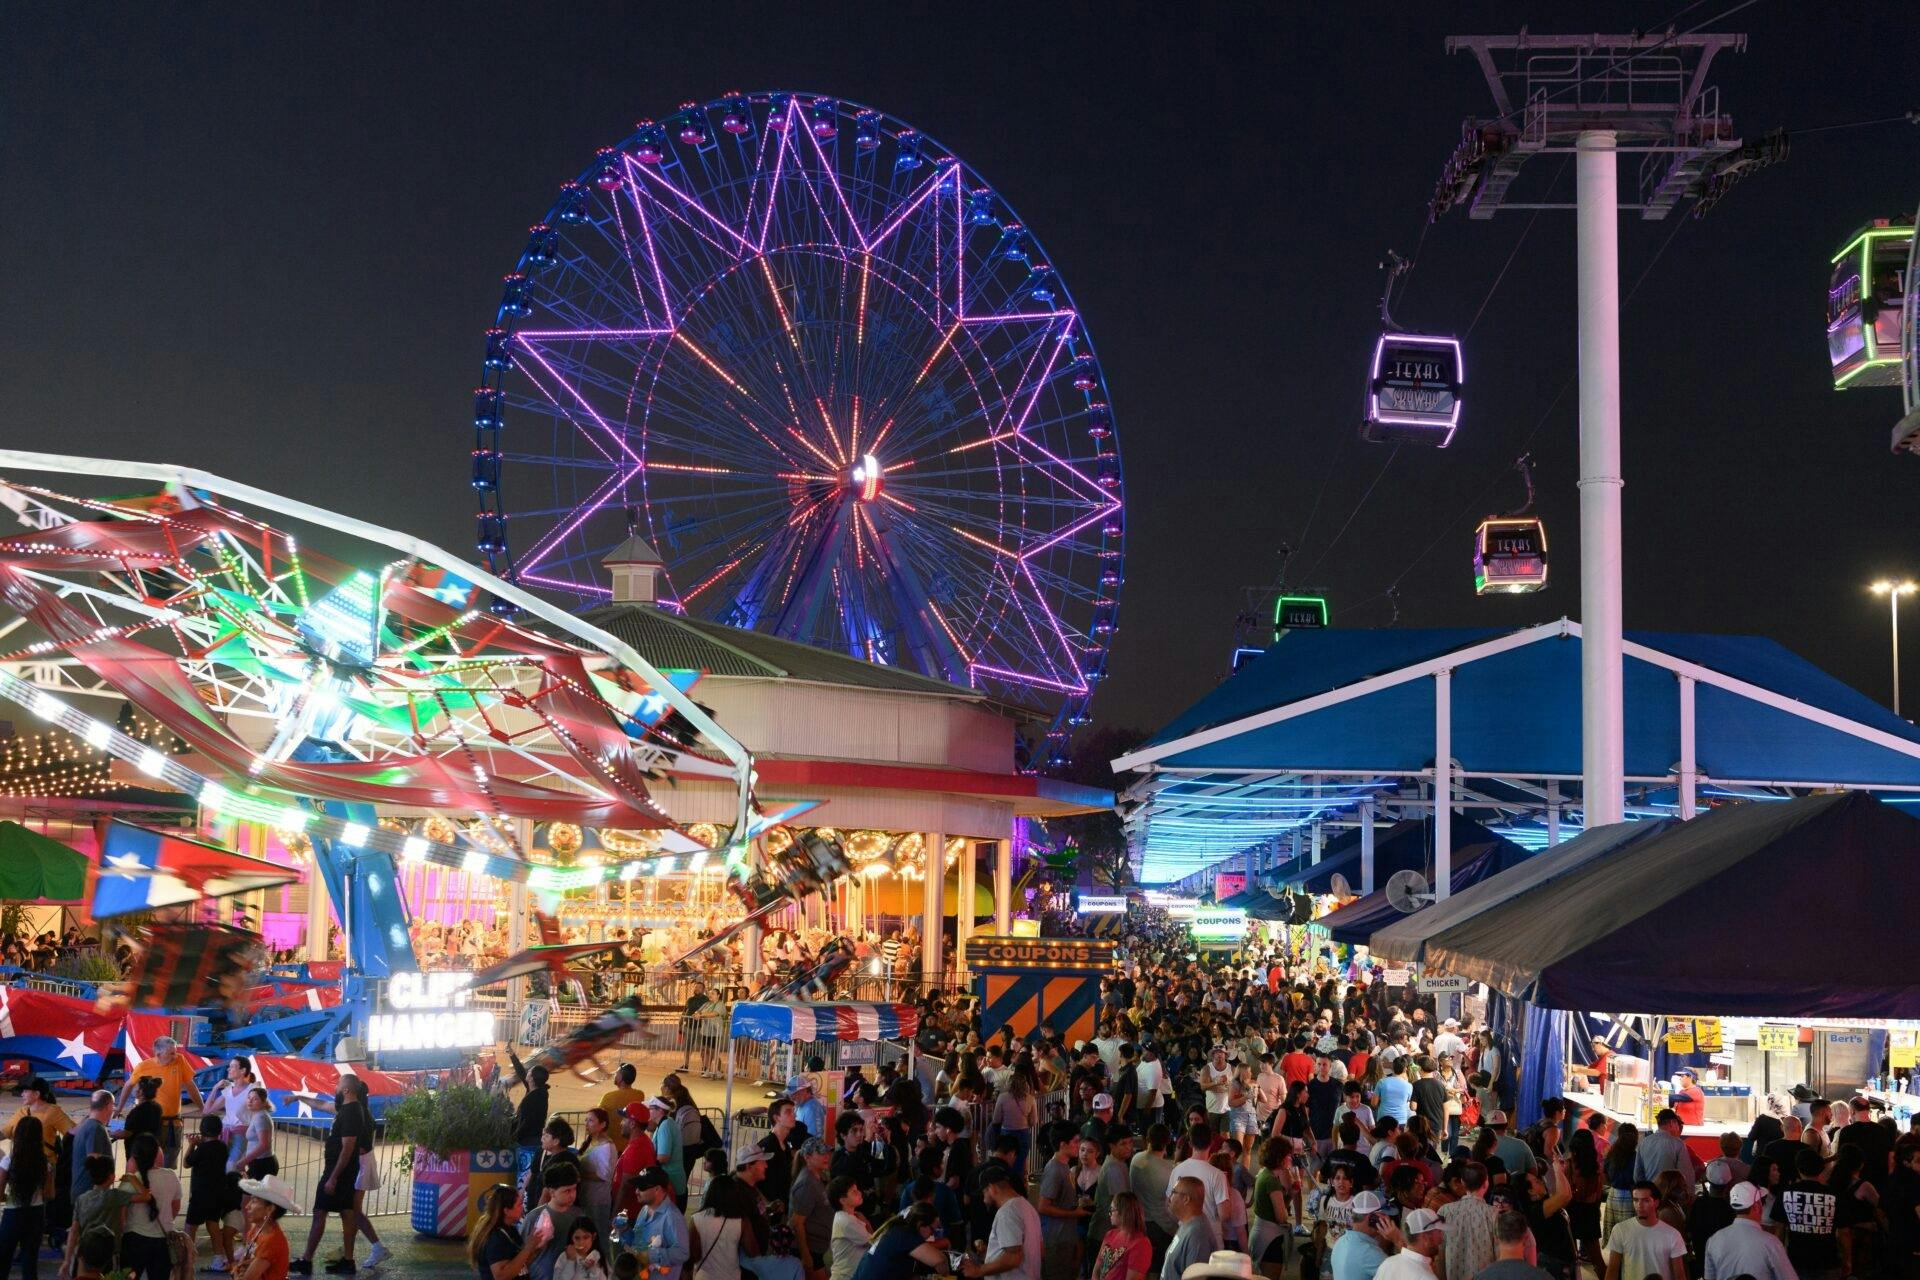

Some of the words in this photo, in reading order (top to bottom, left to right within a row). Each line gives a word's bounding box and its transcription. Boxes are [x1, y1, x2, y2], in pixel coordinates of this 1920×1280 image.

[1395, 362, 1440, 380] TEXAS
[1498, 540, 1530, 551] TEXAS
[1290, 613, 1315, 623] TEXAS
[1197, 917, 1241, 925] COUPONS
[988, 946, 1089, 961] COUPONS
[1426, 979, 1460, 988] CHICKEN
[367, 1011, 495, 1051] HANGER
[1830, 1034, 1863, 1043] Bert's
[742, 1115, 768, 1128] EXIT
[1783, 1191, 1836, 1206] AFTER
[1784, 1202, 1836, 1217] DEATH
[1790, 1223, 1832, 1234] OREVER
